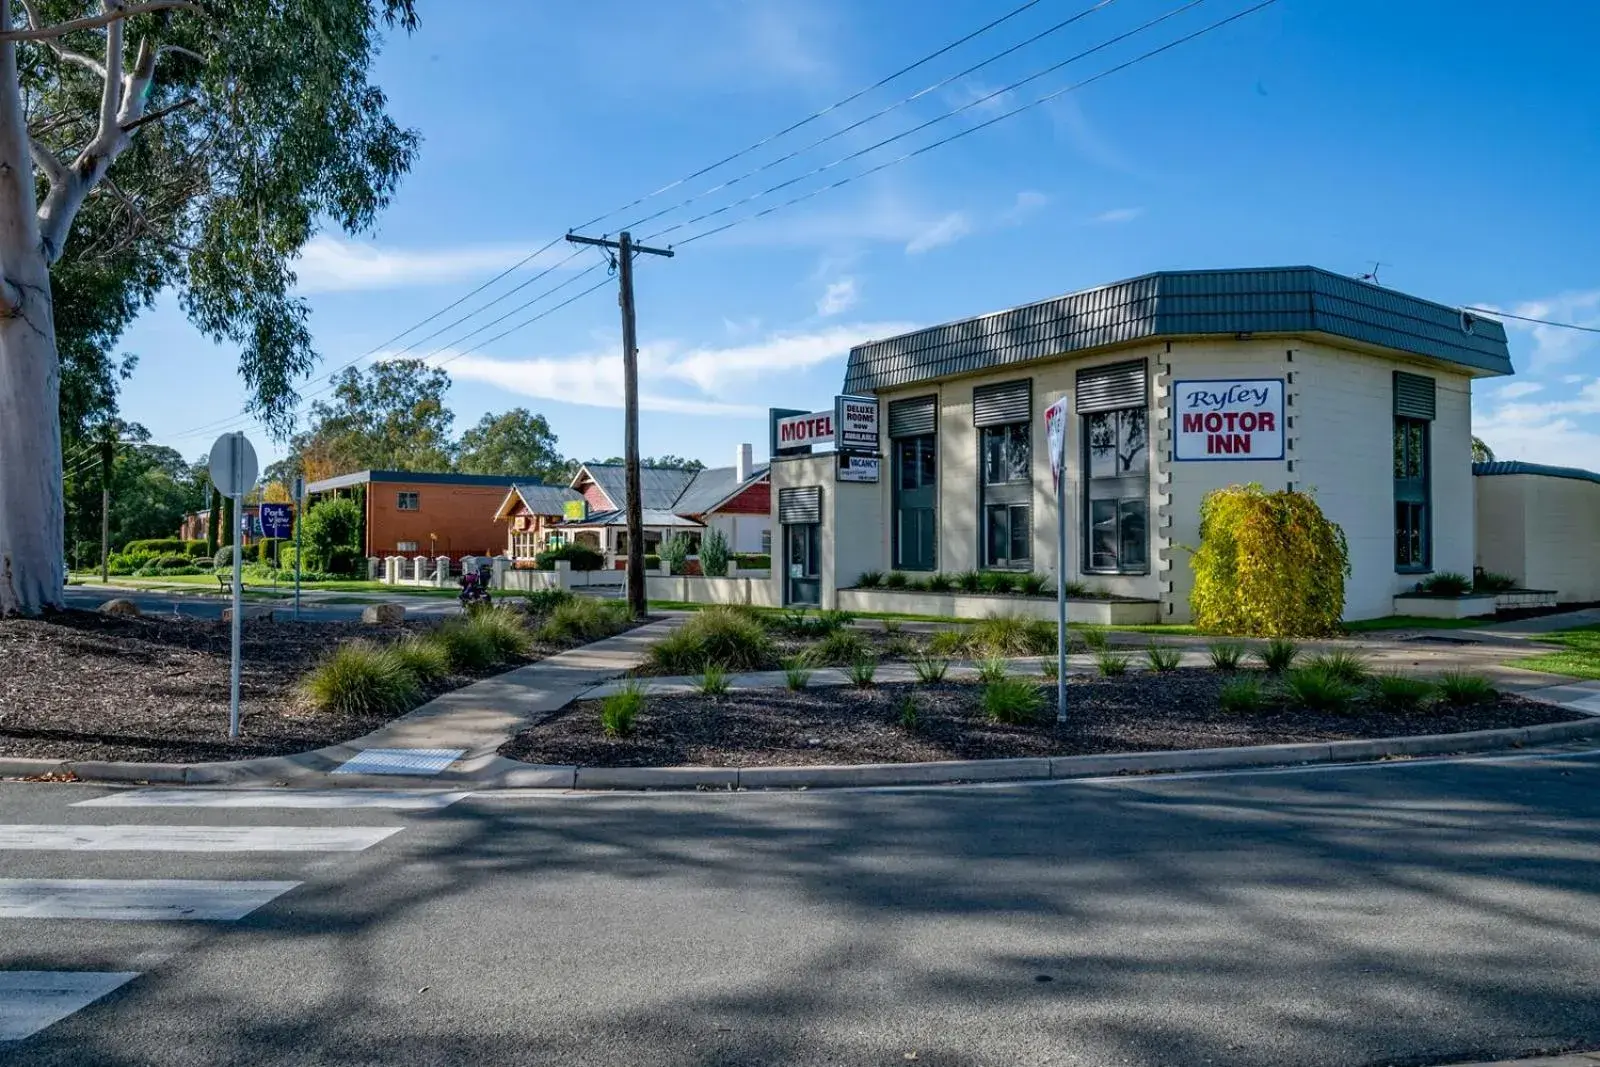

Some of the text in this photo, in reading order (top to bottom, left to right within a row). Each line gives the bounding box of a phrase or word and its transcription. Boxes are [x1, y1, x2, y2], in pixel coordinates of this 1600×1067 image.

[1186, 384, 1269, 411] Ryley
[847, 404, 874, 413] DELUXE
[847, 413, 874, 422] ROOMS
[1183, 412, 1275, 433] MOTOR
[782, 416, 834, 441] MOTEL
[1207, 434, 1251, 454] INN
[850, 458, 877, 468] VACANCY
[264, 507, 284, 516] Park
